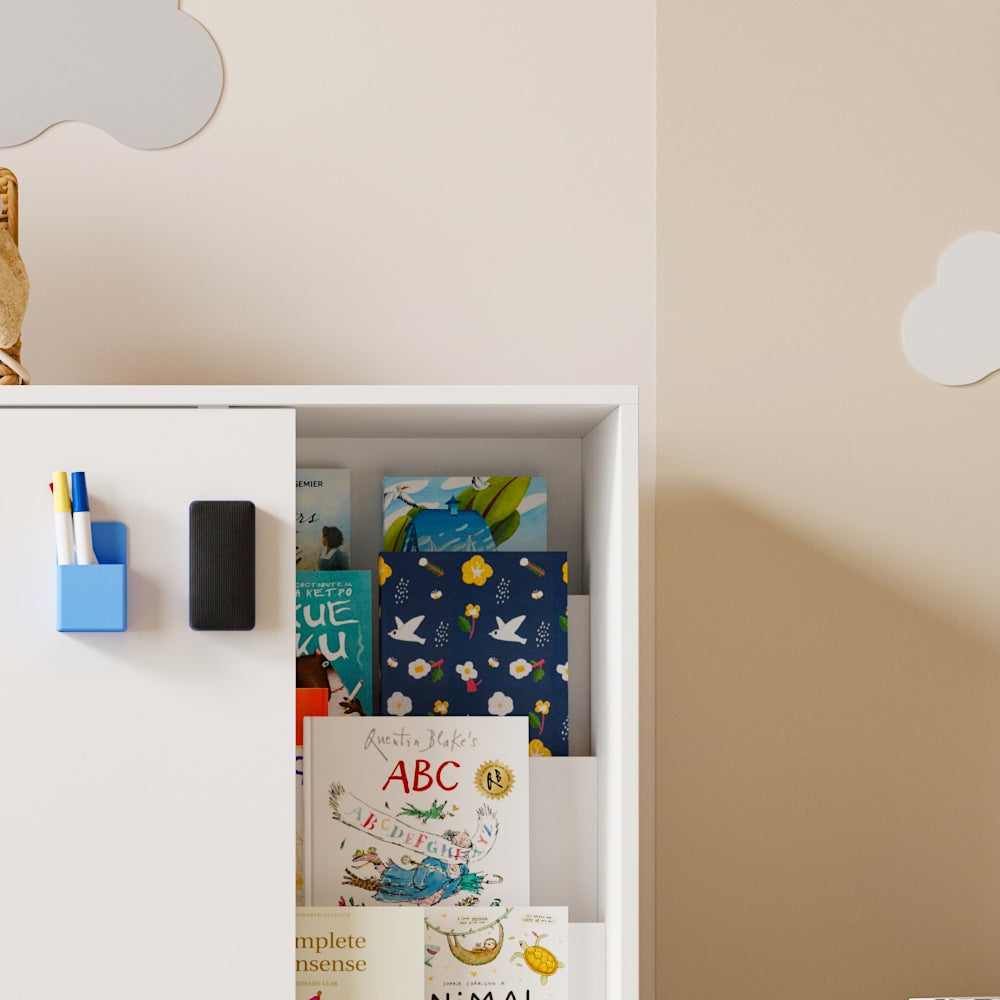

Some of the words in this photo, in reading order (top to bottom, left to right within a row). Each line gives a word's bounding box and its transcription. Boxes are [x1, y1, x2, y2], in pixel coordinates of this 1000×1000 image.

[418, 728, 478, 753] Blake's
[382, 759, 461, 794] ABC
[296, 931, 367, 954] mplete
[296, 959, 367, 972] nsense
